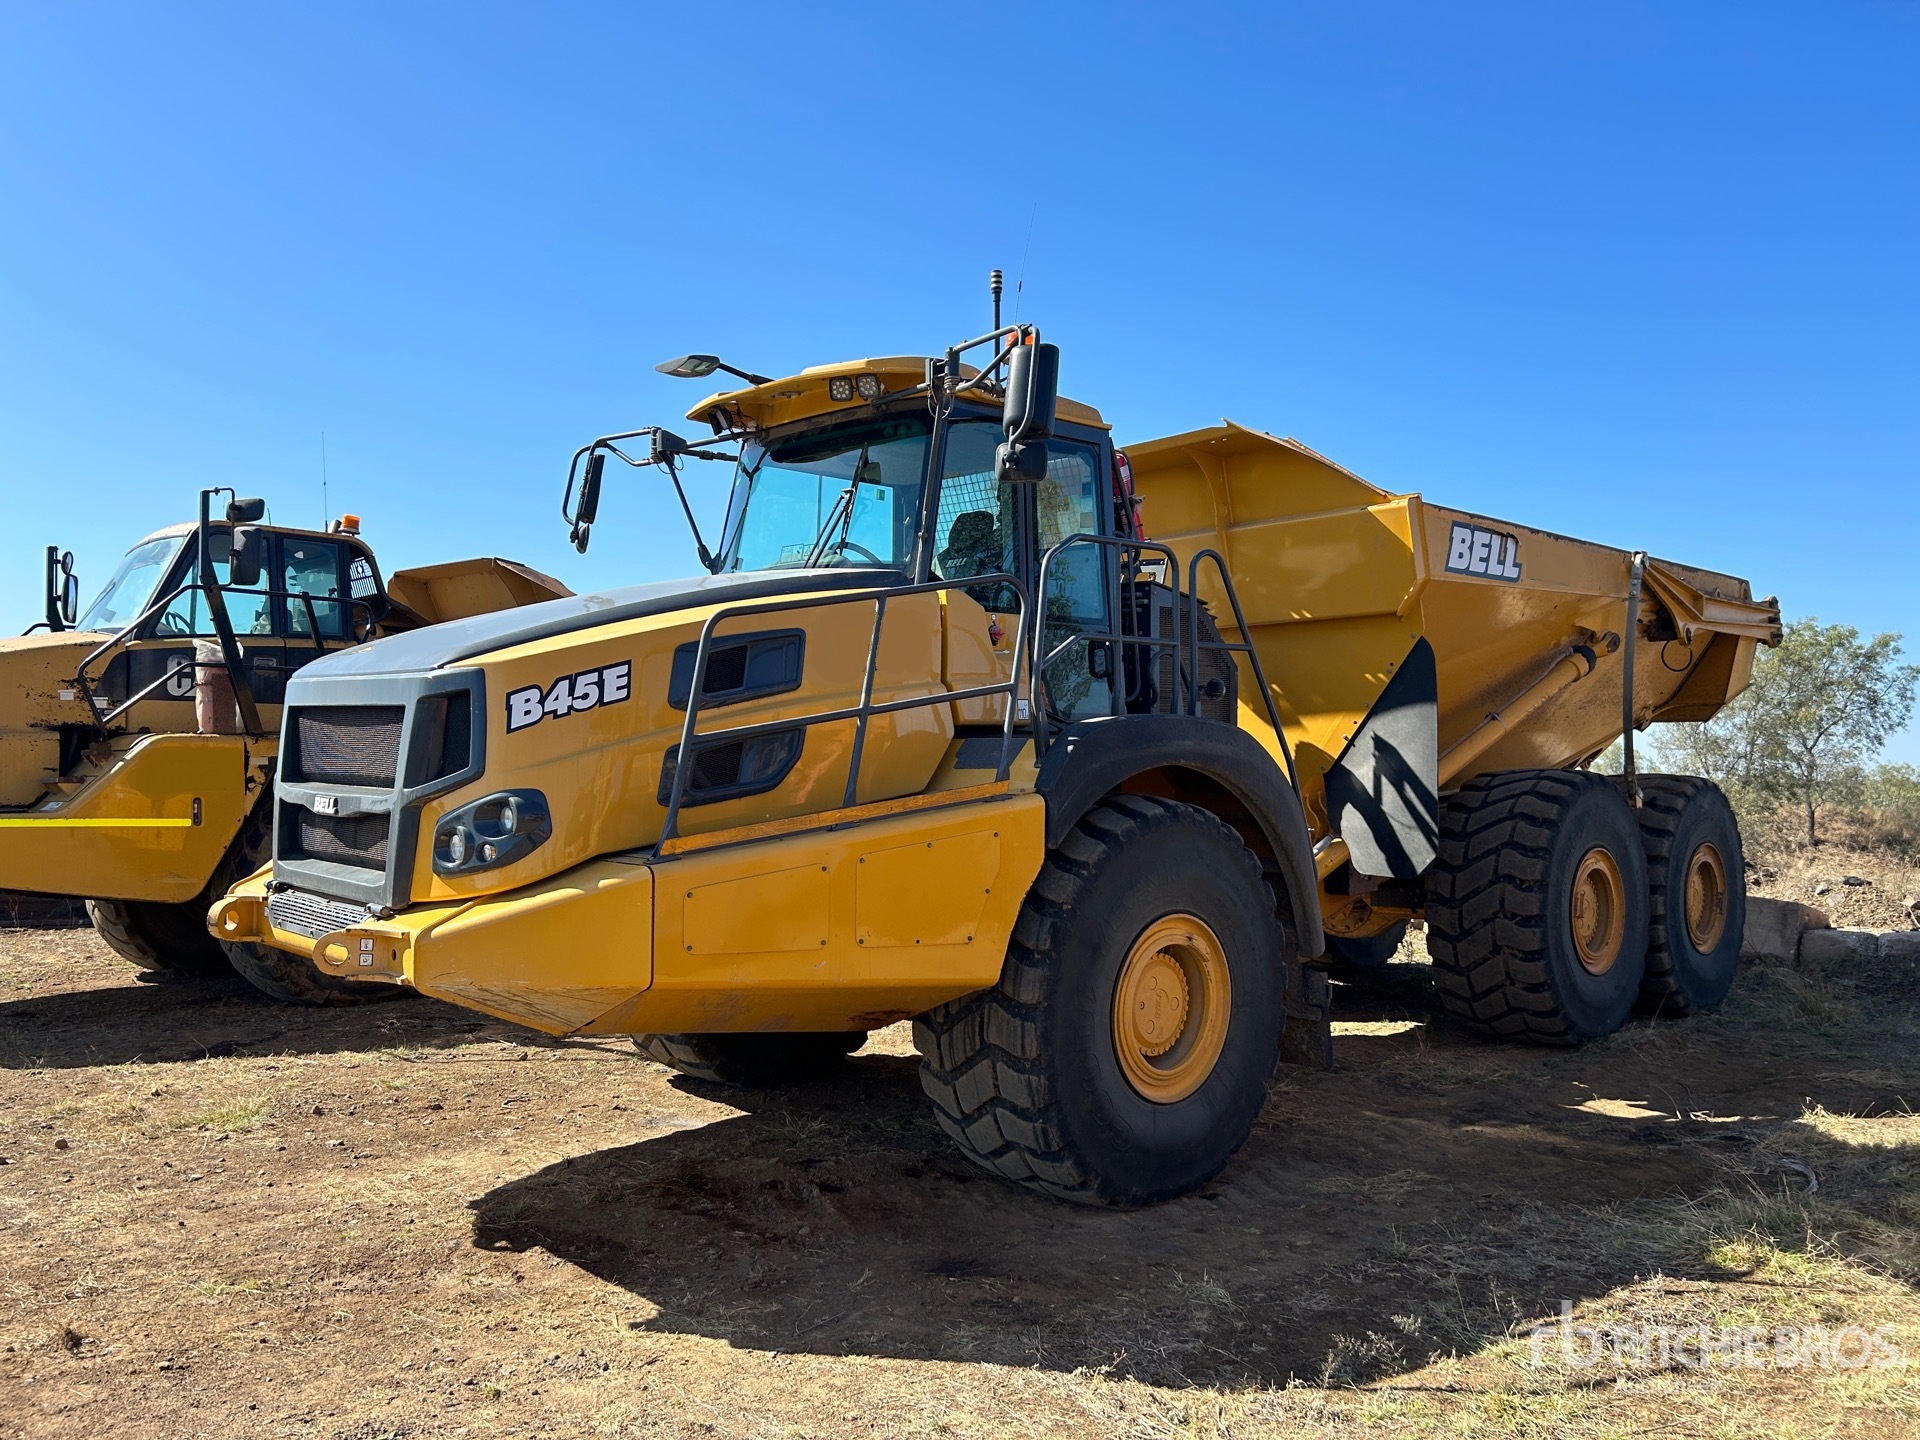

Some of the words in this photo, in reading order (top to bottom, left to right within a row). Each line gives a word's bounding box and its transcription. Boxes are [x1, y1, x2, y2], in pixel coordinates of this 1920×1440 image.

[1446, 523, 1521, 580] BELL
[507, 661, 632, 732] B45E
[313, 795, 337, 814] BELL
